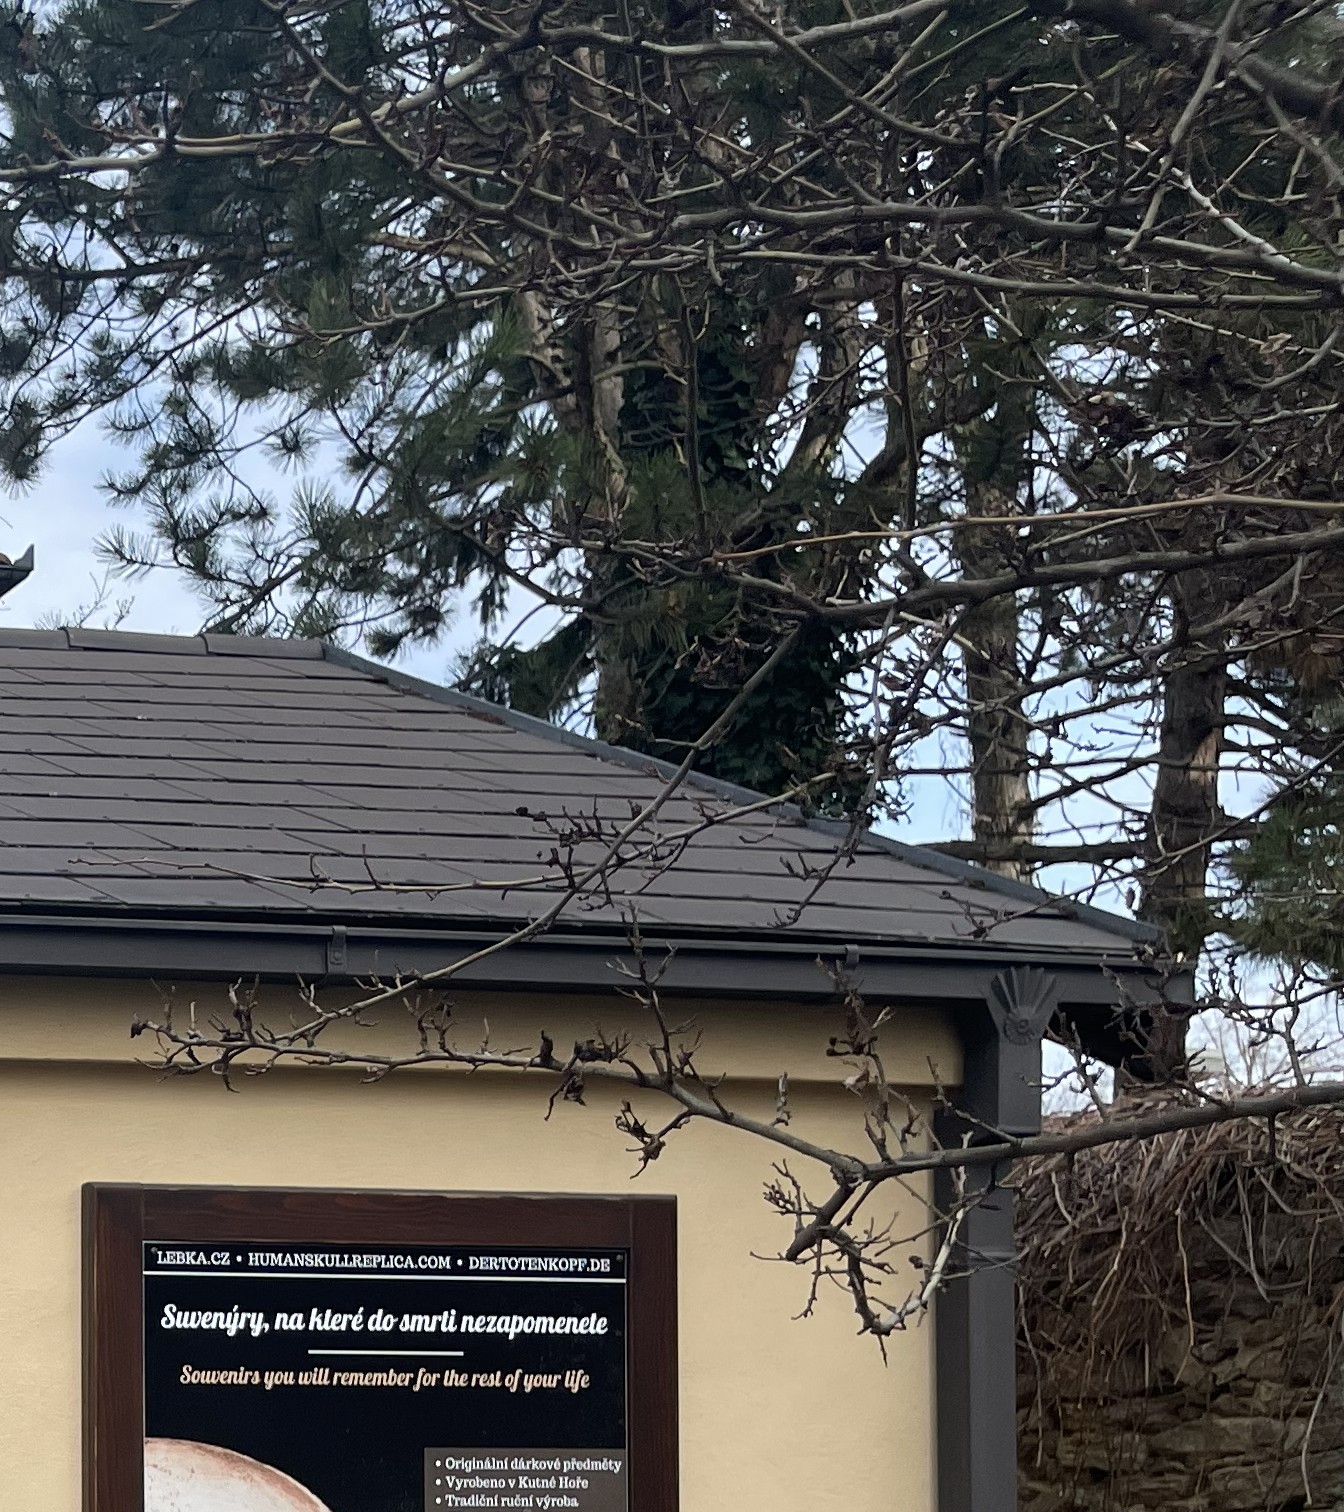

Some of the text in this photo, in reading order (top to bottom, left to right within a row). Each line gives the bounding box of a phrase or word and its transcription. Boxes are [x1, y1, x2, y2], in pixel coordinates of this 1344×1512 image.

[157, 1251, 610, 1272] LEBKA.CZ HUMANSKULLREPLICA.COM DERTOTENKOPF.DE
[161, 1304, 609, 1340] Suvenýry, na které do smrti nezapomenete
[180, 1364, 590, 1393] Souvenirs you will remember for the rest of your life
[445, 1457, 621, 1474] Originální dárkové předměty
[446, 1476, 588, 1491] Vyrobeno v Kutné Hoře
[445, 1495, 578, 1509] Tradiční ruční výroba
